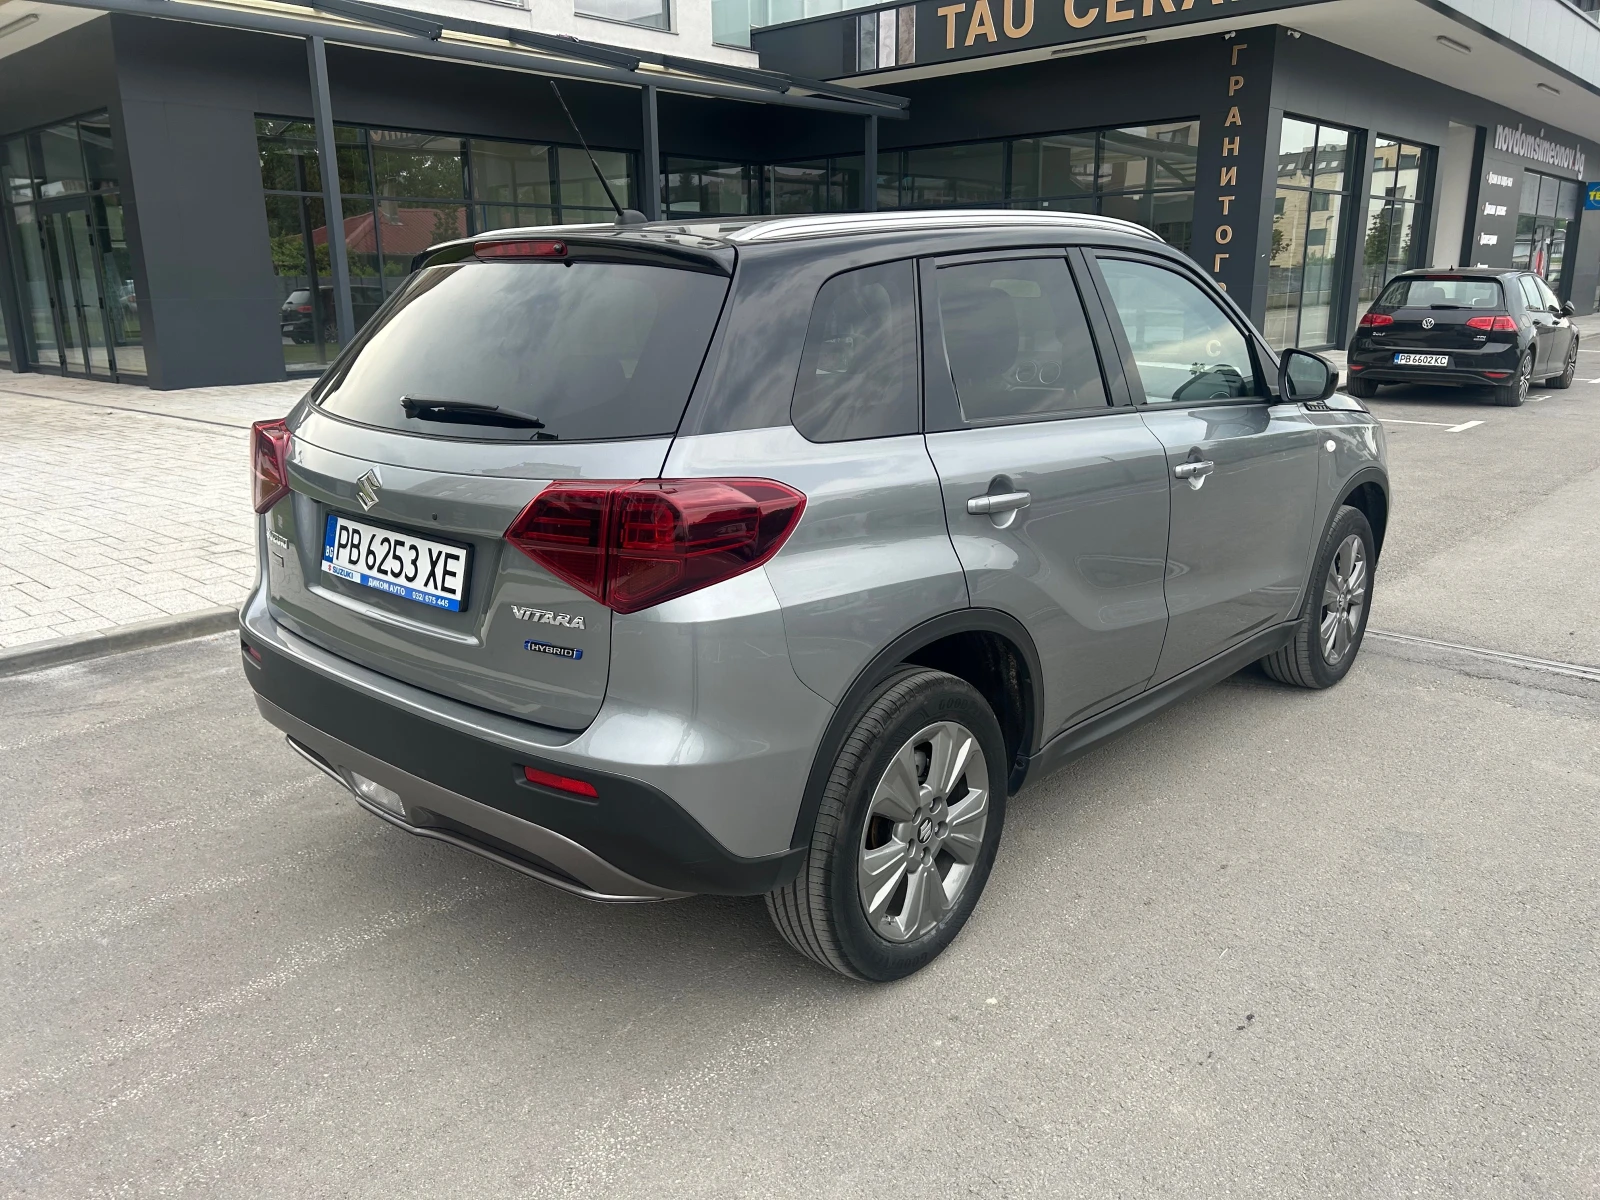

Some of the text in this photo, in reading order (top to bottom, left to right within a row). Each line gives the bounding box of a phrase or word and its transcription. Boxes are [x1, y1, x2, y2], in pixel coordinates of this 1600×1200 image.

[937, 0, 1035, 49] TAU
[1494, 123, 1585, 181] novdomsimeonov.bg
[1400, 355, 1411, 364] PB
[1412, 355, 1433, 365] 6602
[1434, 357, 1447, 365] KC
[325, 524, 460, 595] BG PB 6253 XE
[332, 565, 354, 580] SUZUKI
[367, 578, 389, 591] ДИКОМ
[389, 583, 406, 596] АУТО
[425, 595, 436, 604] 675
[437, 598, 449, 607] 445
[510, 604, 586, 630] VITARA
[531, 643, 573, 657] HYBRID
